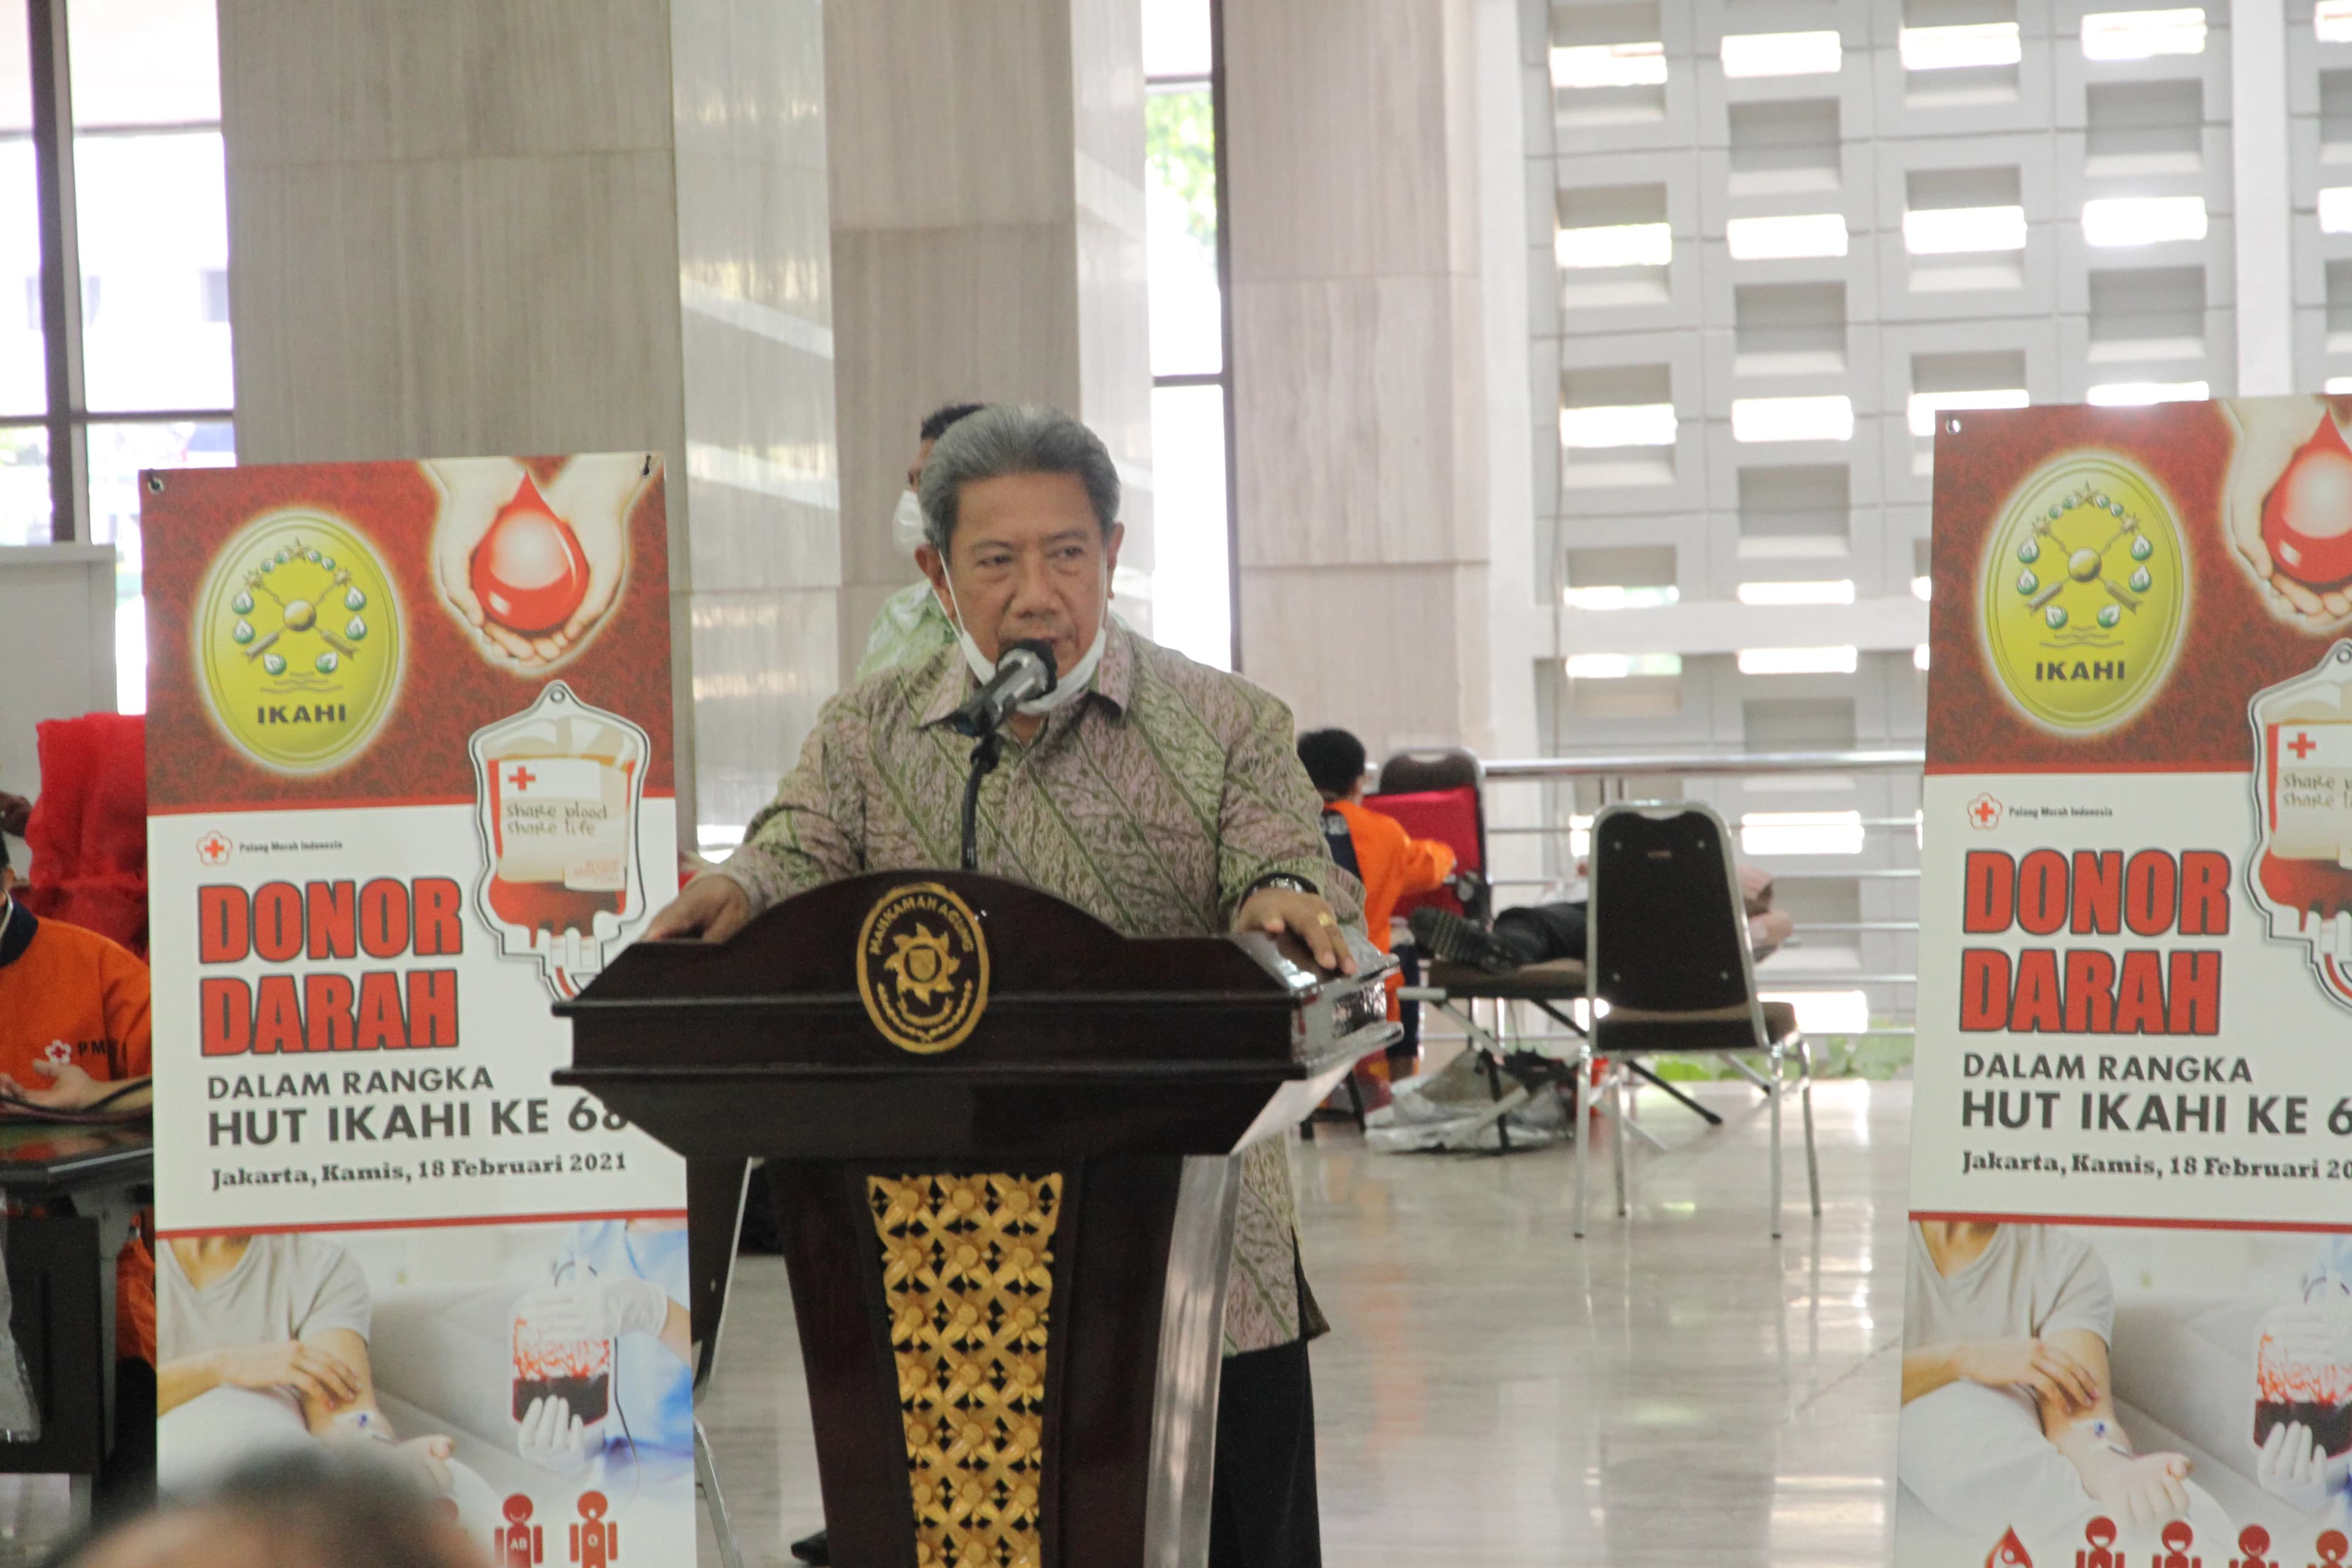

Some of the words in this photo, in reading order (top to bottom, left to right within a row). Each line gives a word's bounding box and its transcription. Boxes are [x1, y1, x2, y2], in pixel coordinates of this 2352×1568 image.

[2037, 661, 2124, 680] IKAHI
[258, 704, 346, 724] IKAHI
[1962, 848, 2231, 936] DONOR
[198, 876, 462, 964] DONOR
[1959, 948, 2222, 1036] DARAH
[200, 967, 459, 1057] DARAH
[208, 1072, 331, 1099] DALAM
[343, 1066, 494, 1095] RANGKA
[1964, 1052, 2086, 1080] DALAM
[2098, 1054, 2253, 1083] RANGKA
[209, 1107, 307, 1147] HUT
[328, 1101, 470, 1142] IKAHI
[491, 1098, 548, 1135] KE
[1962, 1090, 2060, 1129] HUT
[2081, 1091, 2226, 1133] IKAHI
[2248, 1095, 2307, 1135] KE
[211, 1167, 317, 1191] Jakarta,
[322, 1162, 412, 1184] Kamis,
[419, 1159, 445, 1178] 18
[451, 1155, 563, 1177] Februari
[570, 1152, 627, 1172] 2021
[1962, 1150, 2067, 1178] Jakarta,
[2071, 1153, 2163, 1180] Kamis,
[2171, 1156, 2197, 1175] 18
[2204, 1155, 2320, 1178] Februari
[510, 1537, 528, 1551] AB
